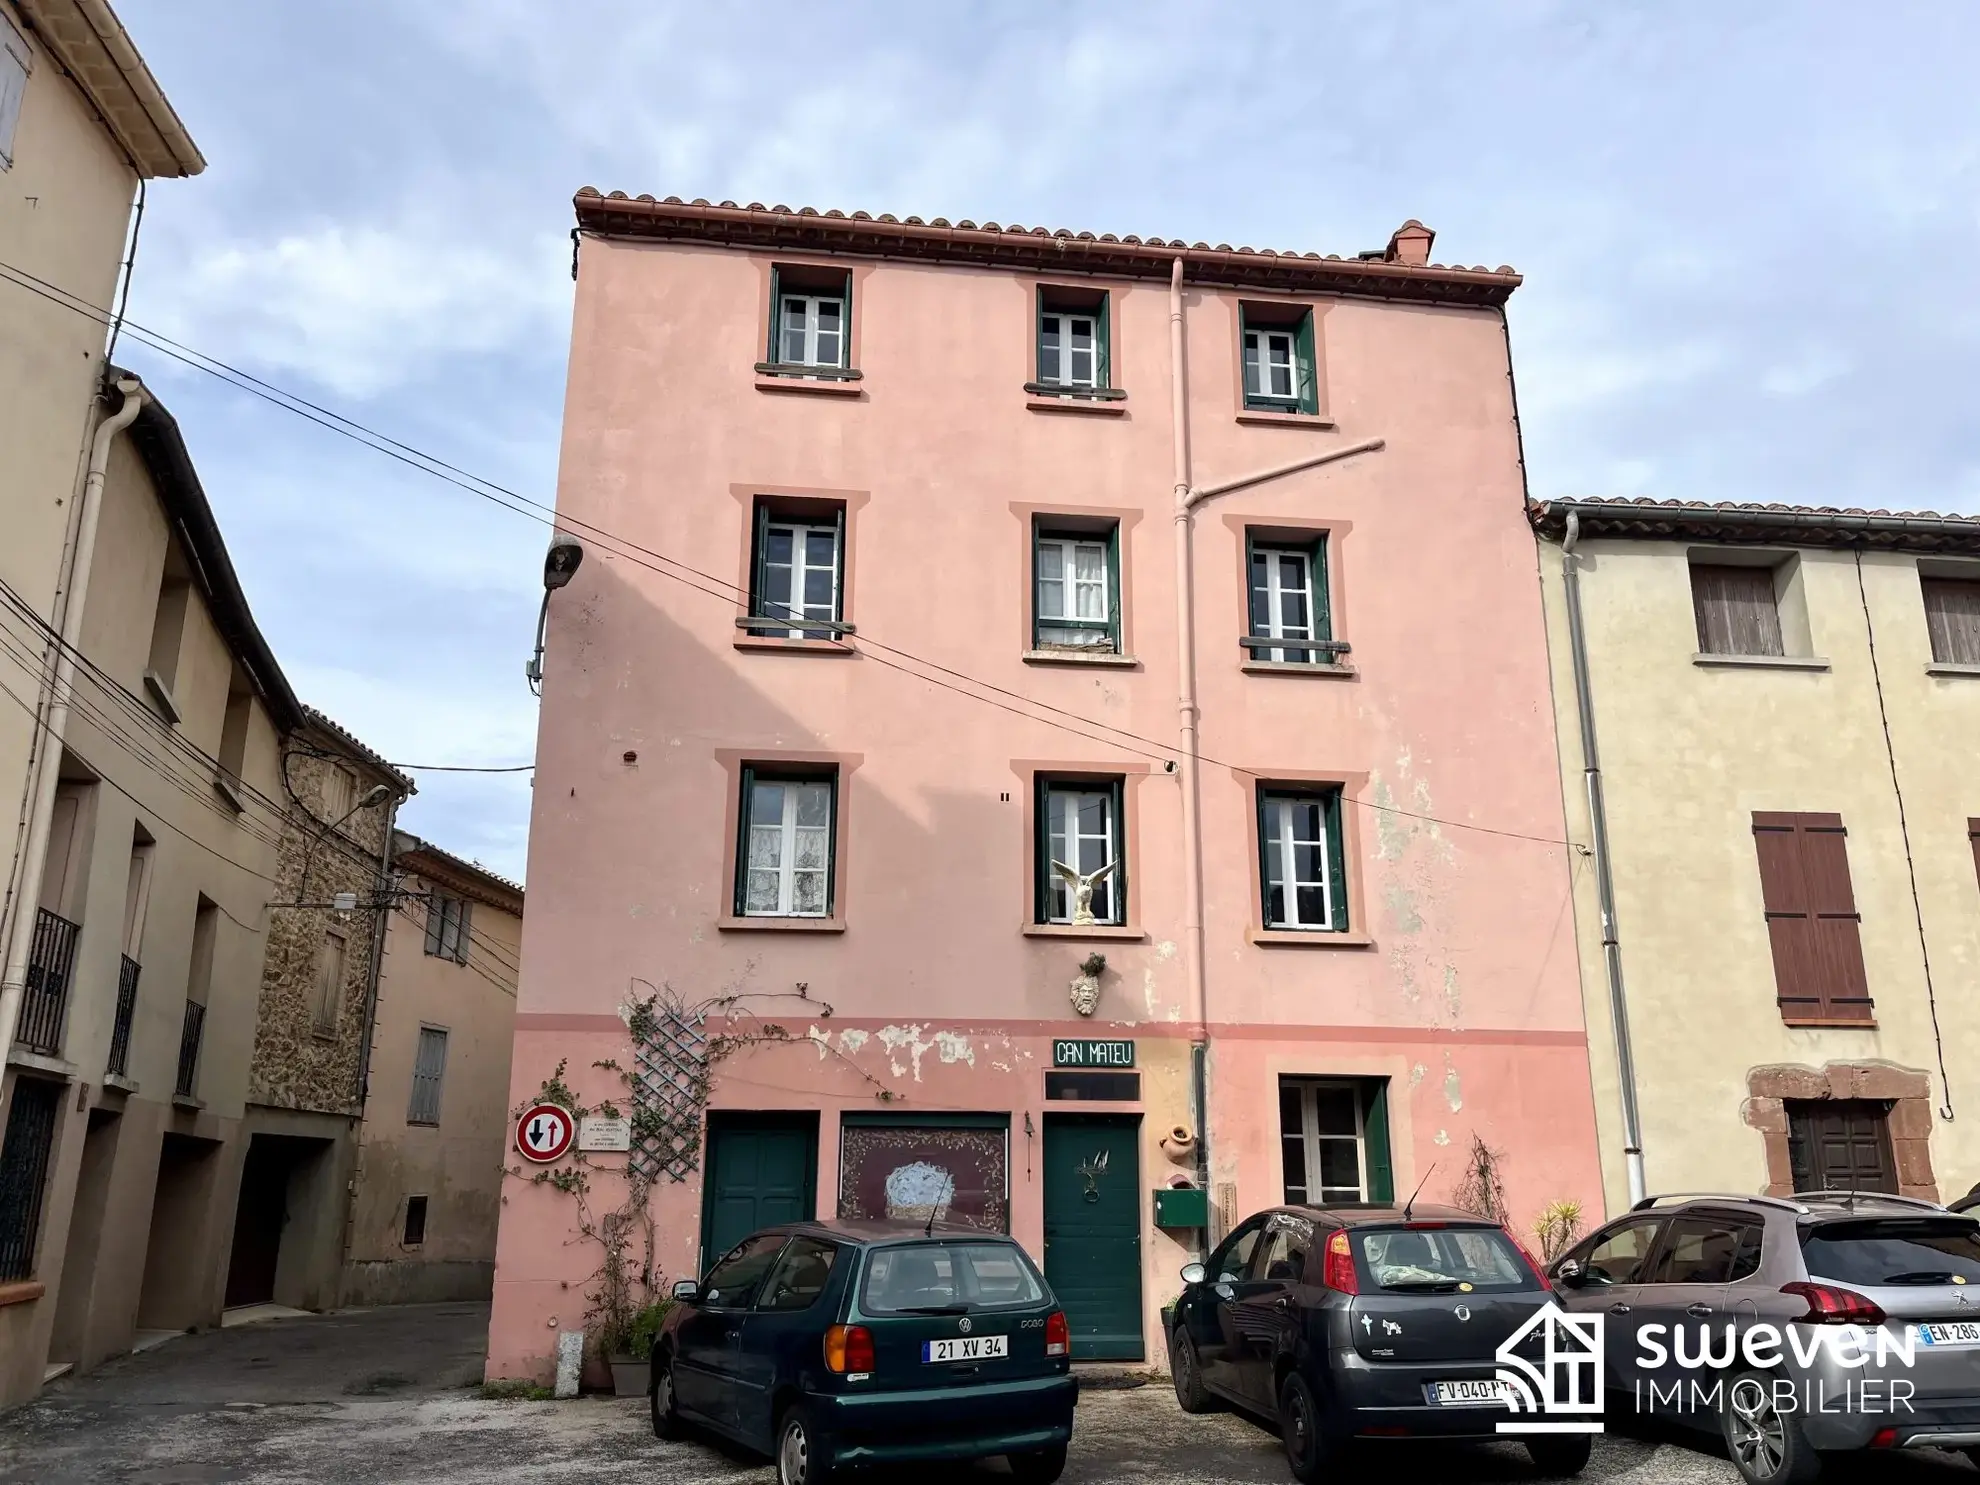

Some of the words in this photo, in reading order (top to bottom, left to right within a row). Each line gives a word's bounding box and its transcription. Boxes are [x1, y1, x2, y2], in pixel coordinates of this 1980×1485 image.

[1057, 1042, 1083, 1063] CAN
[1089, 1042, 1132, 1064] MATEU
[938, 1342, 953, 1359] 21
[963, 1340, 980, 1356] XV
[984, 1338, 1002, 1355] 34
